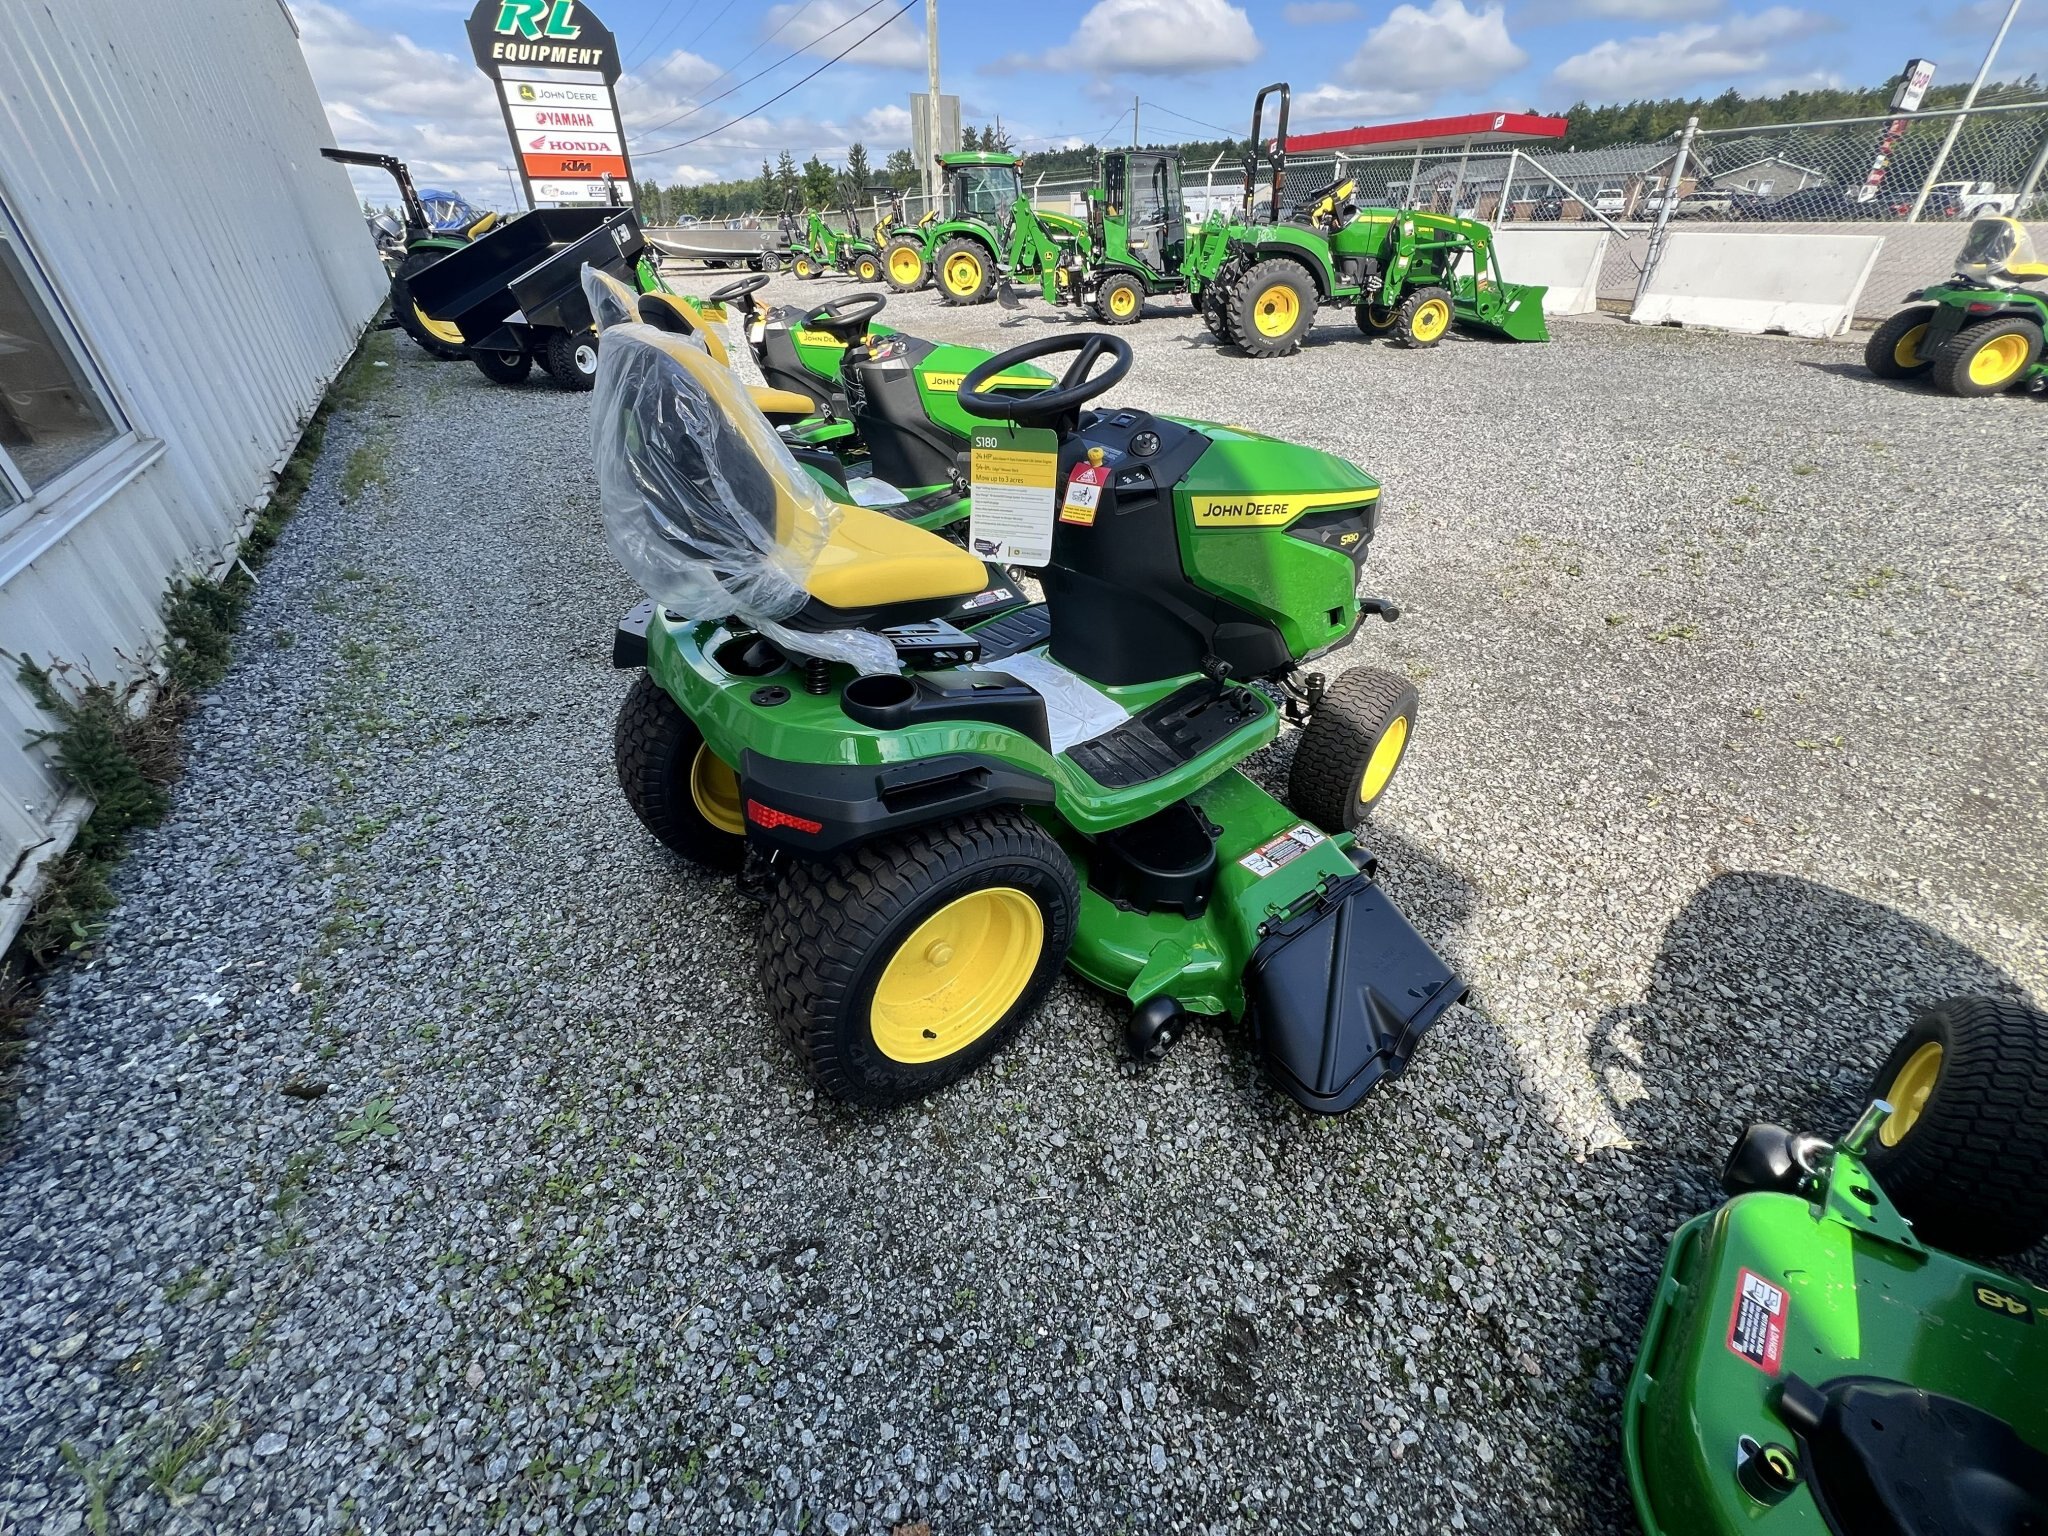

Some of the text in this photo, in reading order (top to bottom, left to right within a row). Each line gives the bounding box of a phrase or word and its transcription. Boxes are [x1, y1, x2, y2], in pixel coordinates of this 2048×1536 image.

[495, 0, 581, 41] RL
[492, 42, 603, 65] EQUIPMENT
[539, 89, 598, 101] JOHN DEERE
[547, 112, 594, 127] YAMAHA
[549, 140, 612, 152] HONDA
[561, 159, 592, 172] KTM
[932, 377, 955, 385] JOHN
[975, 437, 998, 448] S180
[975, 452, 983, 460] 24
[1203, 502, 1289, 517] JOHN DEERE
[1340, 532, 1359, 546] S180
[1978, 1288, 2028, 1314] 48
[1767, 1331, 1780, 1361] DANGER
